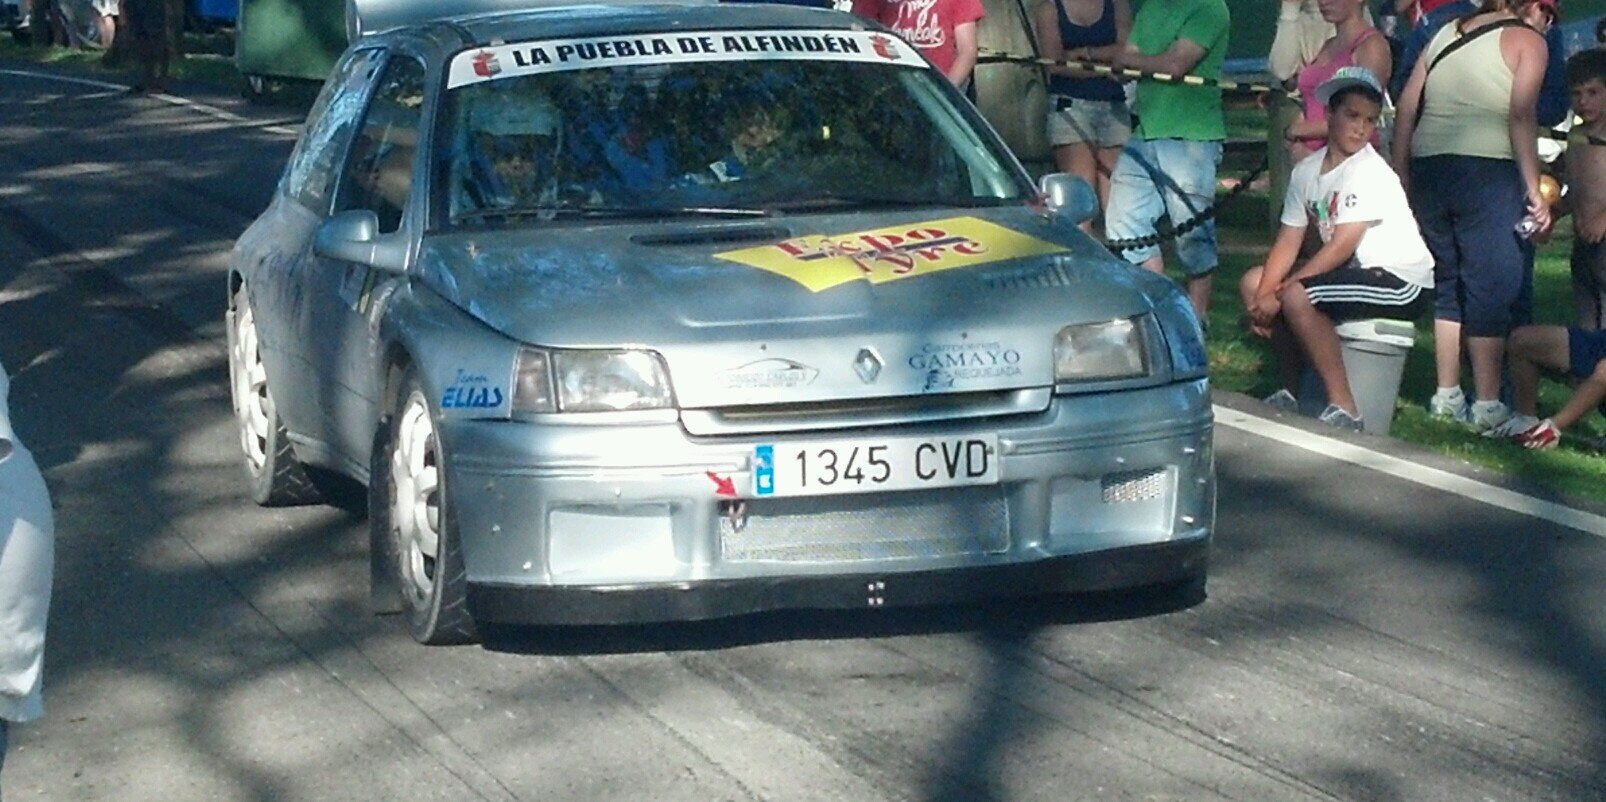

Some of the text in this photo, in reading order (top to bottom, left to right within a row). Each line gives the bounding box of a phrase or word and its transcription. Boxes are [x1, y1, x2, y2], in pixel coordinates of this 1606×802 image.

[512, 33, 861, 67] LA PUEBLA DE ALFINDÉN
[908, 349, 1021, 370] GAMAYO
[441, 387, 503, 408] ELIAS
[796, 439, 988, 487] 1345 CVD
